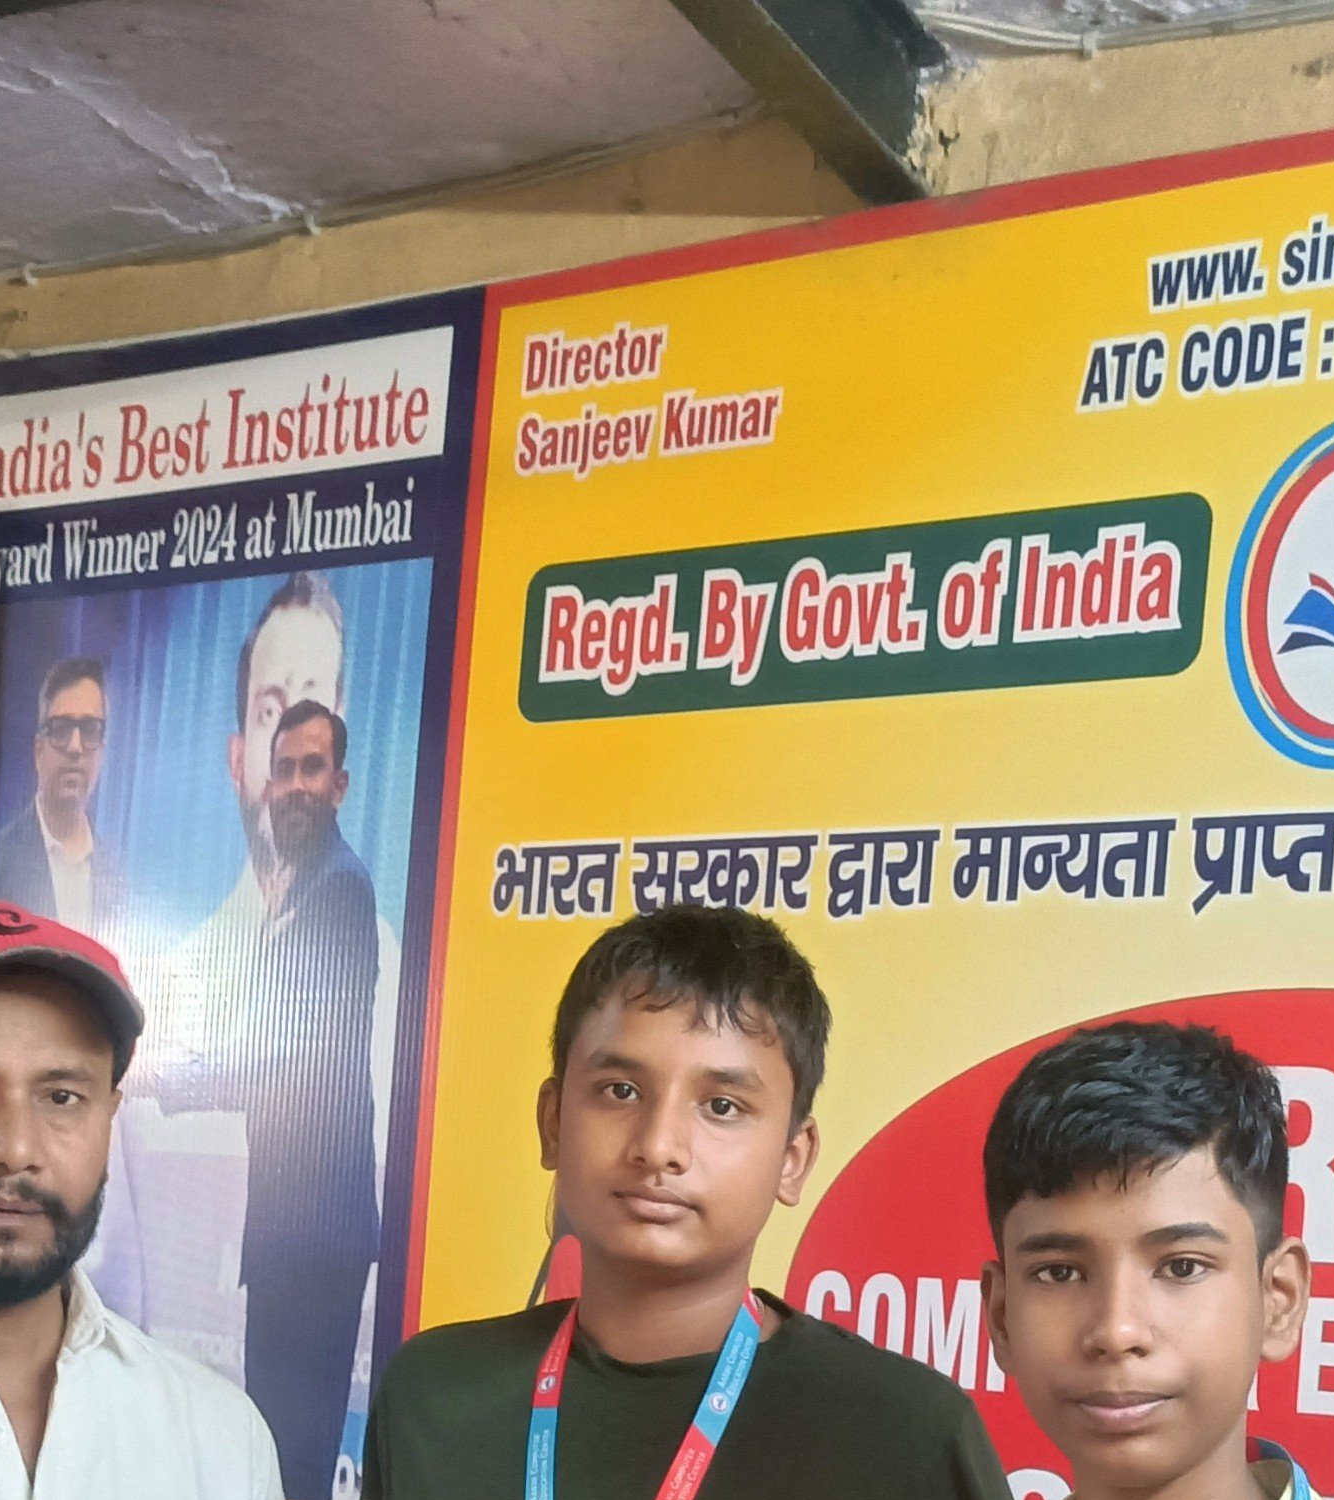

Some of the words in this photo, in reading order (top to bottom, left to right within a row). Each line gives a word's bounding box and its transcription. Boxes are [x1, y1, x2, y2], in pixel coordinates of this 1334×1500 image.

[1149, 248, 1264, 308] www.
[525, 328, 665, 393] Director
[1079, 339, 1167, 408] ATC
[1180, 315, 1307, 393] CODE
[113, 401, 213, 484] Best
[220, 371, 430, 472] Institute
[517, 415, 653, 475] Sanjeev
[663, 392, 780, 450] Kumar
[62, 511, 166, 582] Winner
[170, 503, 239, 568] 2024
[244, 510, 276, 555] at
[282, 477, 415, 555] Mumbai
[545, 584, 688, 687] Regd.
[702, 576, 768, 676] By
[783, 561, 922, 652] Govt.
[942, 547, 1005, 641] of
[1021, 533, 1175, 632] India
[491, 840, 622, 915] भारत
[629, 833, 820, 914] सरकार
[826, 828, 941, 918] द्वारा
[951, 818, 1177, 903] मान्यता
